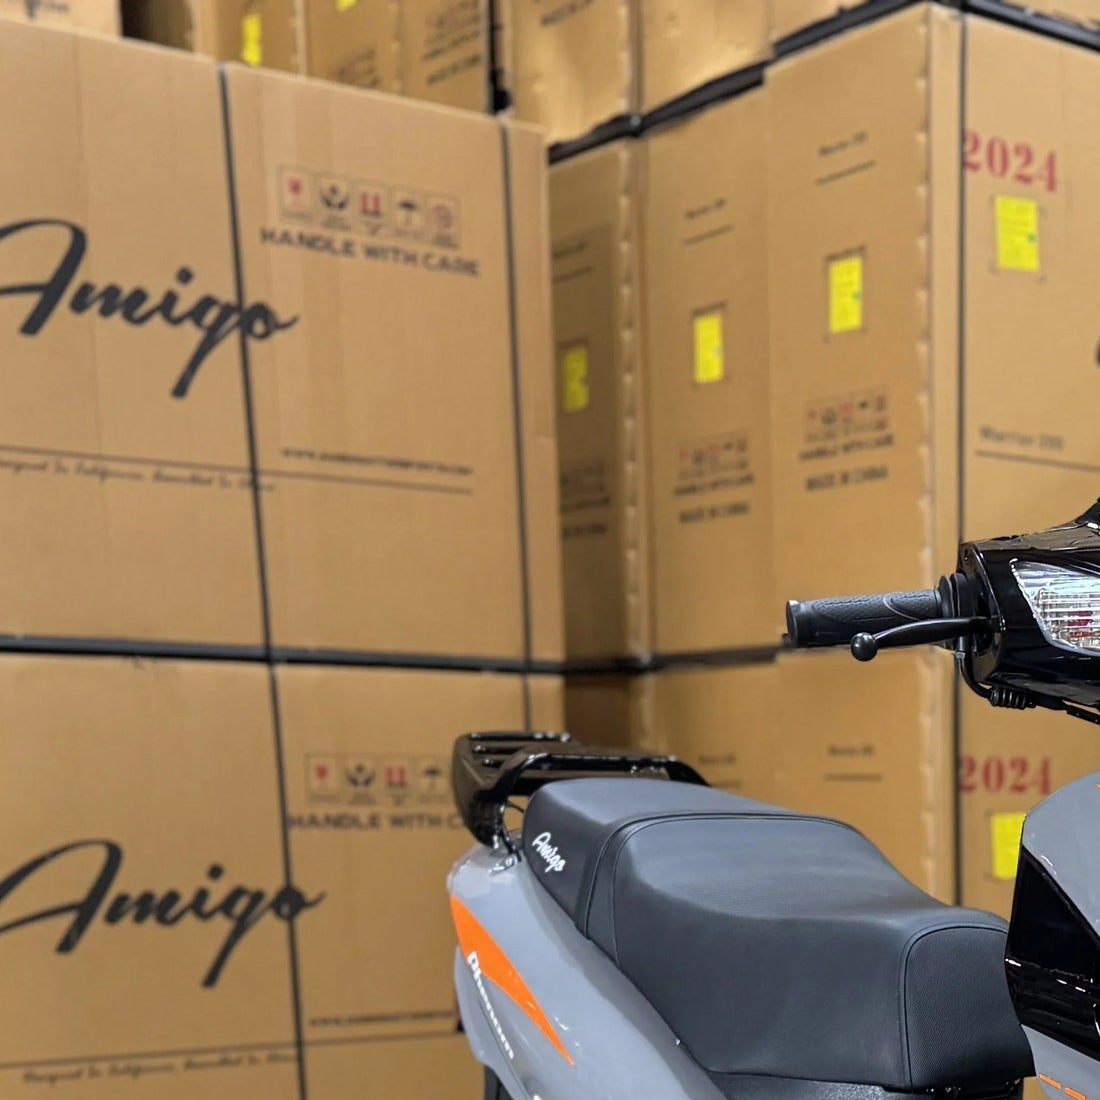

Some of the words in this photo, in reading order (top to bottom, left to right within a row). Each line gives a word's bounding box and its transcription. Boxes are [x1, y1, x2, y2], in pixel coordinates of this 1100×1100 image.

[260, 227, 356, 259] HANDLE
[364, 244, 417, 267] WITH
[421, 252, 478, 278] CARE
[0, 218, 298, 399] Amigo
[959, 756, 1052, 796] 2024
[286, 812, 381, 831] HANDLE
[531, 831, 566, 873] Amigo
[0, 839, 325, 989] Amigo
